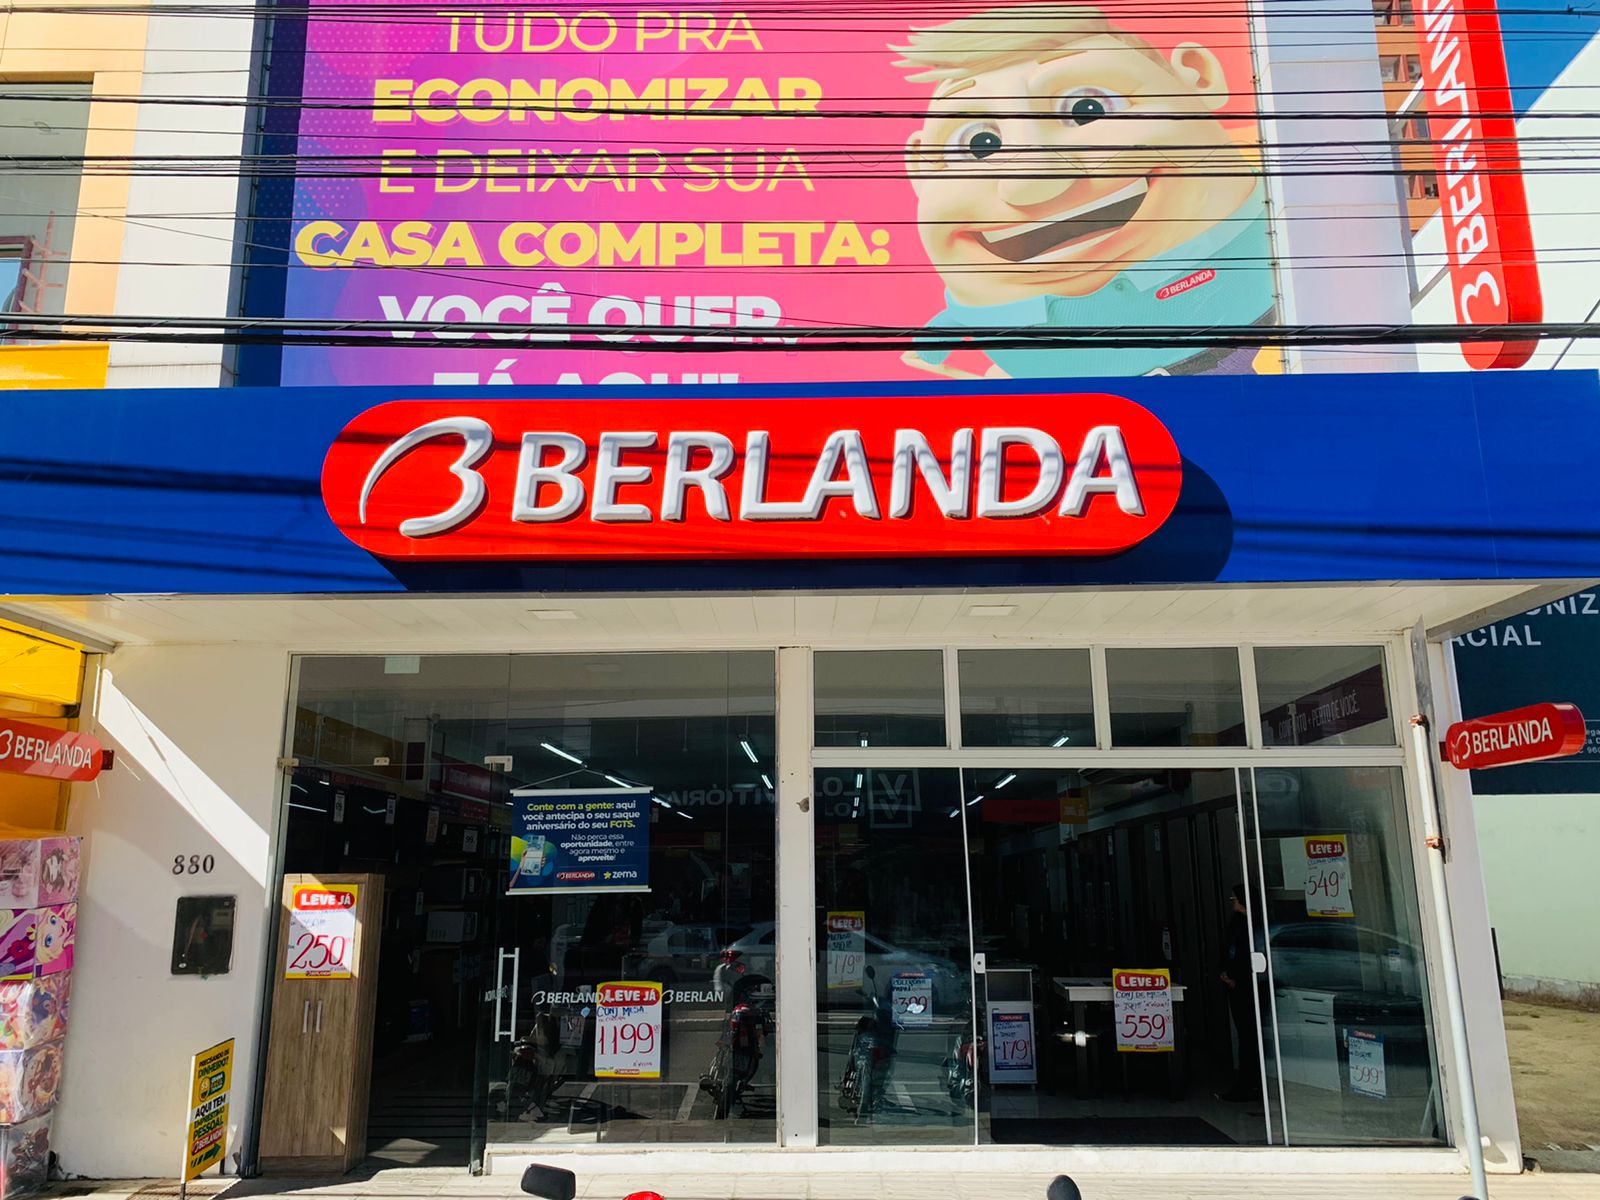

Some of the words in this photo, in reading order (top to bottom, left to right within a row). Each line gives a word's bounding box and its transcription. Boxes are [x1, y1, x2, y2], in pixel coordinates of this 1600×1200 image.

[436, 11, 616, 52] TUDO
[636, 11, 763, 51] PRA
[371, 77, 824, 122] ECONOMIZAR
[379, 150, 415, 193] E
[436, 148, 679, 193] DEIXAR
[684, 147, 815, 192] SUA
[294, 221, 484, 267] CASA
[498, 221, 891, 267] COMPLETA:
[1170, 270, 1212, 294] BERLANDA
[378, 282, 571, 342] VOCÊ
[511, 425, 1145, 522] BERLANDA
[1472, 717, 1553, 755] BERLANDA
[14, 735, 92, 769] BERLANDA
[522, 812, 544, 821] você
[546, 811, 584, 821] antecipa
[612, 811, 640, 820] saque
[527, 803, 554, 811] Conte
[585, 802, 614, 811] gente:
[616, 800, 636, 810] aqui
[526, 821, 576, 830] aniversário
[578, 821, 590, 829] do
[610, 820, 636, 829] FGTS.
[560, 840, 614, 849] oportunidade,
[569, 848, 590, 856] agora
[1310, 843, 1332, 854] LEVE
[1334, 842, 1342, 853] JÁ
[172, 854, 215, 875] 880
[612, 870, 637, 879] zema
[1307, 870, 1339, 897] 549
[301, 893, 336, 906] LEVE
[338, 892, 351, 905] JÁ
[1120, 976, 1153, 987] LEVE
[1155, 976, 1165, 987] JÁ
[605, 989, 641, 1002] LEVE
[643, 989, 656, 1001] JÁ
[675, 991, 724, 1003] BERLAN
[597, 1006, 618, 1018] CONJ
[598, 1023, 654, 1055] 1199
[1121, 1014, 1166, 1040] 559
[195, 1101, 212, 1119] AQUI
[213, 1093, 226, 1109] TEM
[193, 1115, 223, 1141] PESSOAL
